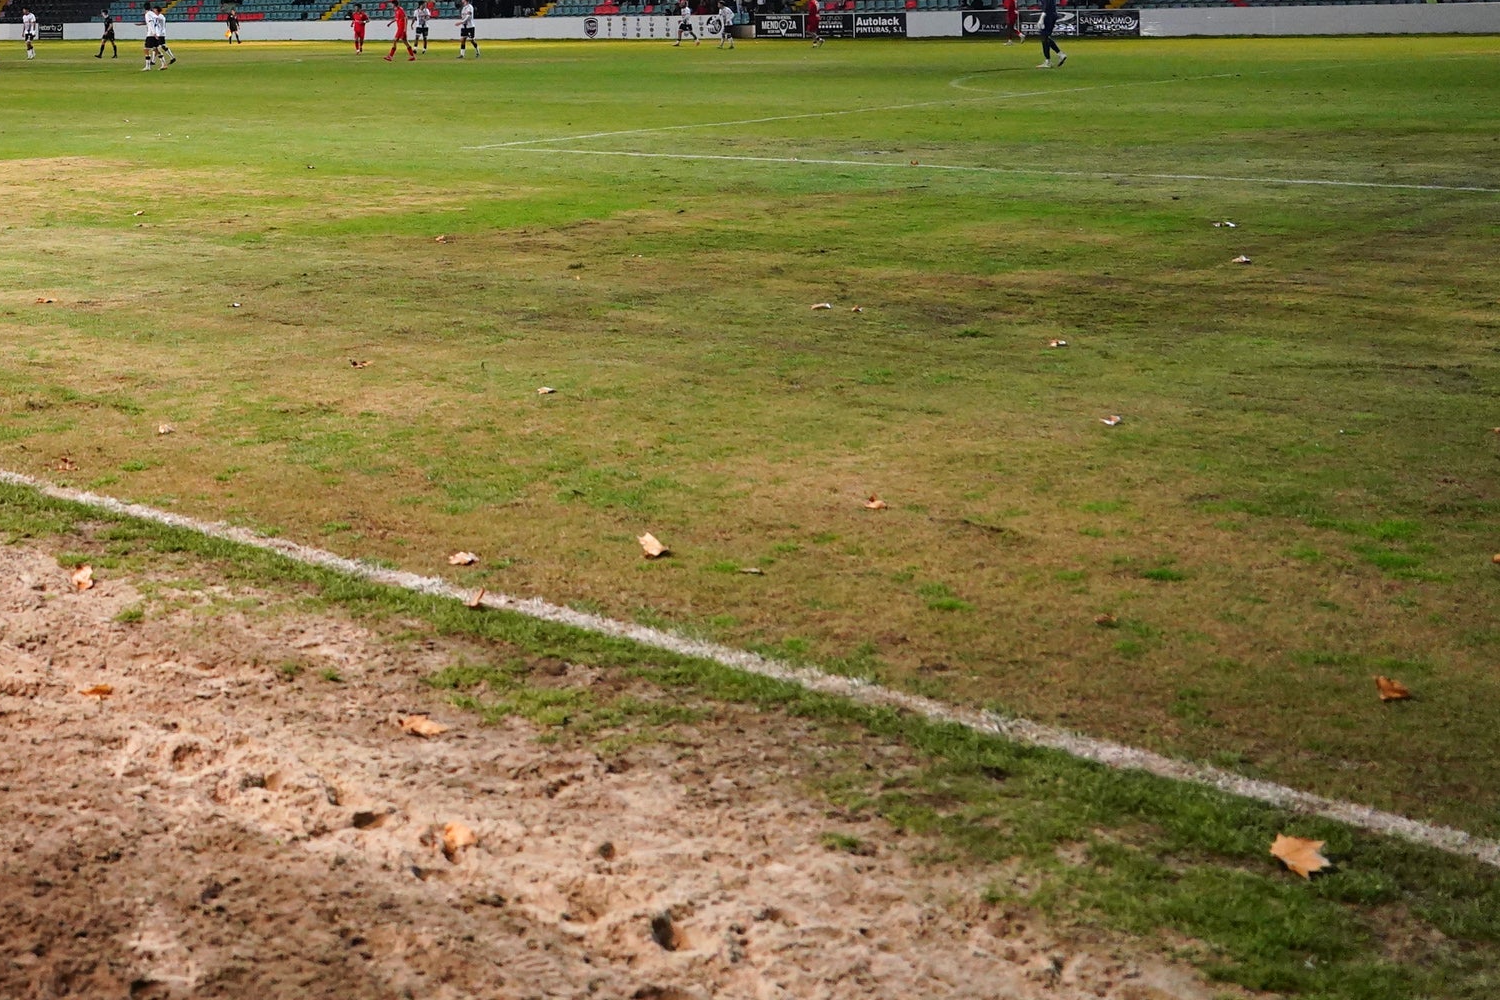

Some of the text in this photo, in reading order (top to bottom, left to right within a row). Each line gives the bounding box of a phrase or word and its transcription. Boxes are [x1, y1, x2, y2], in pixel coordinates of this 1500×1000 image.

[761, 20, 797, 30] MENDOZA
[855, 16, 899, 26] Autolack
[855, 26, 891, 34] PINTURAS,
